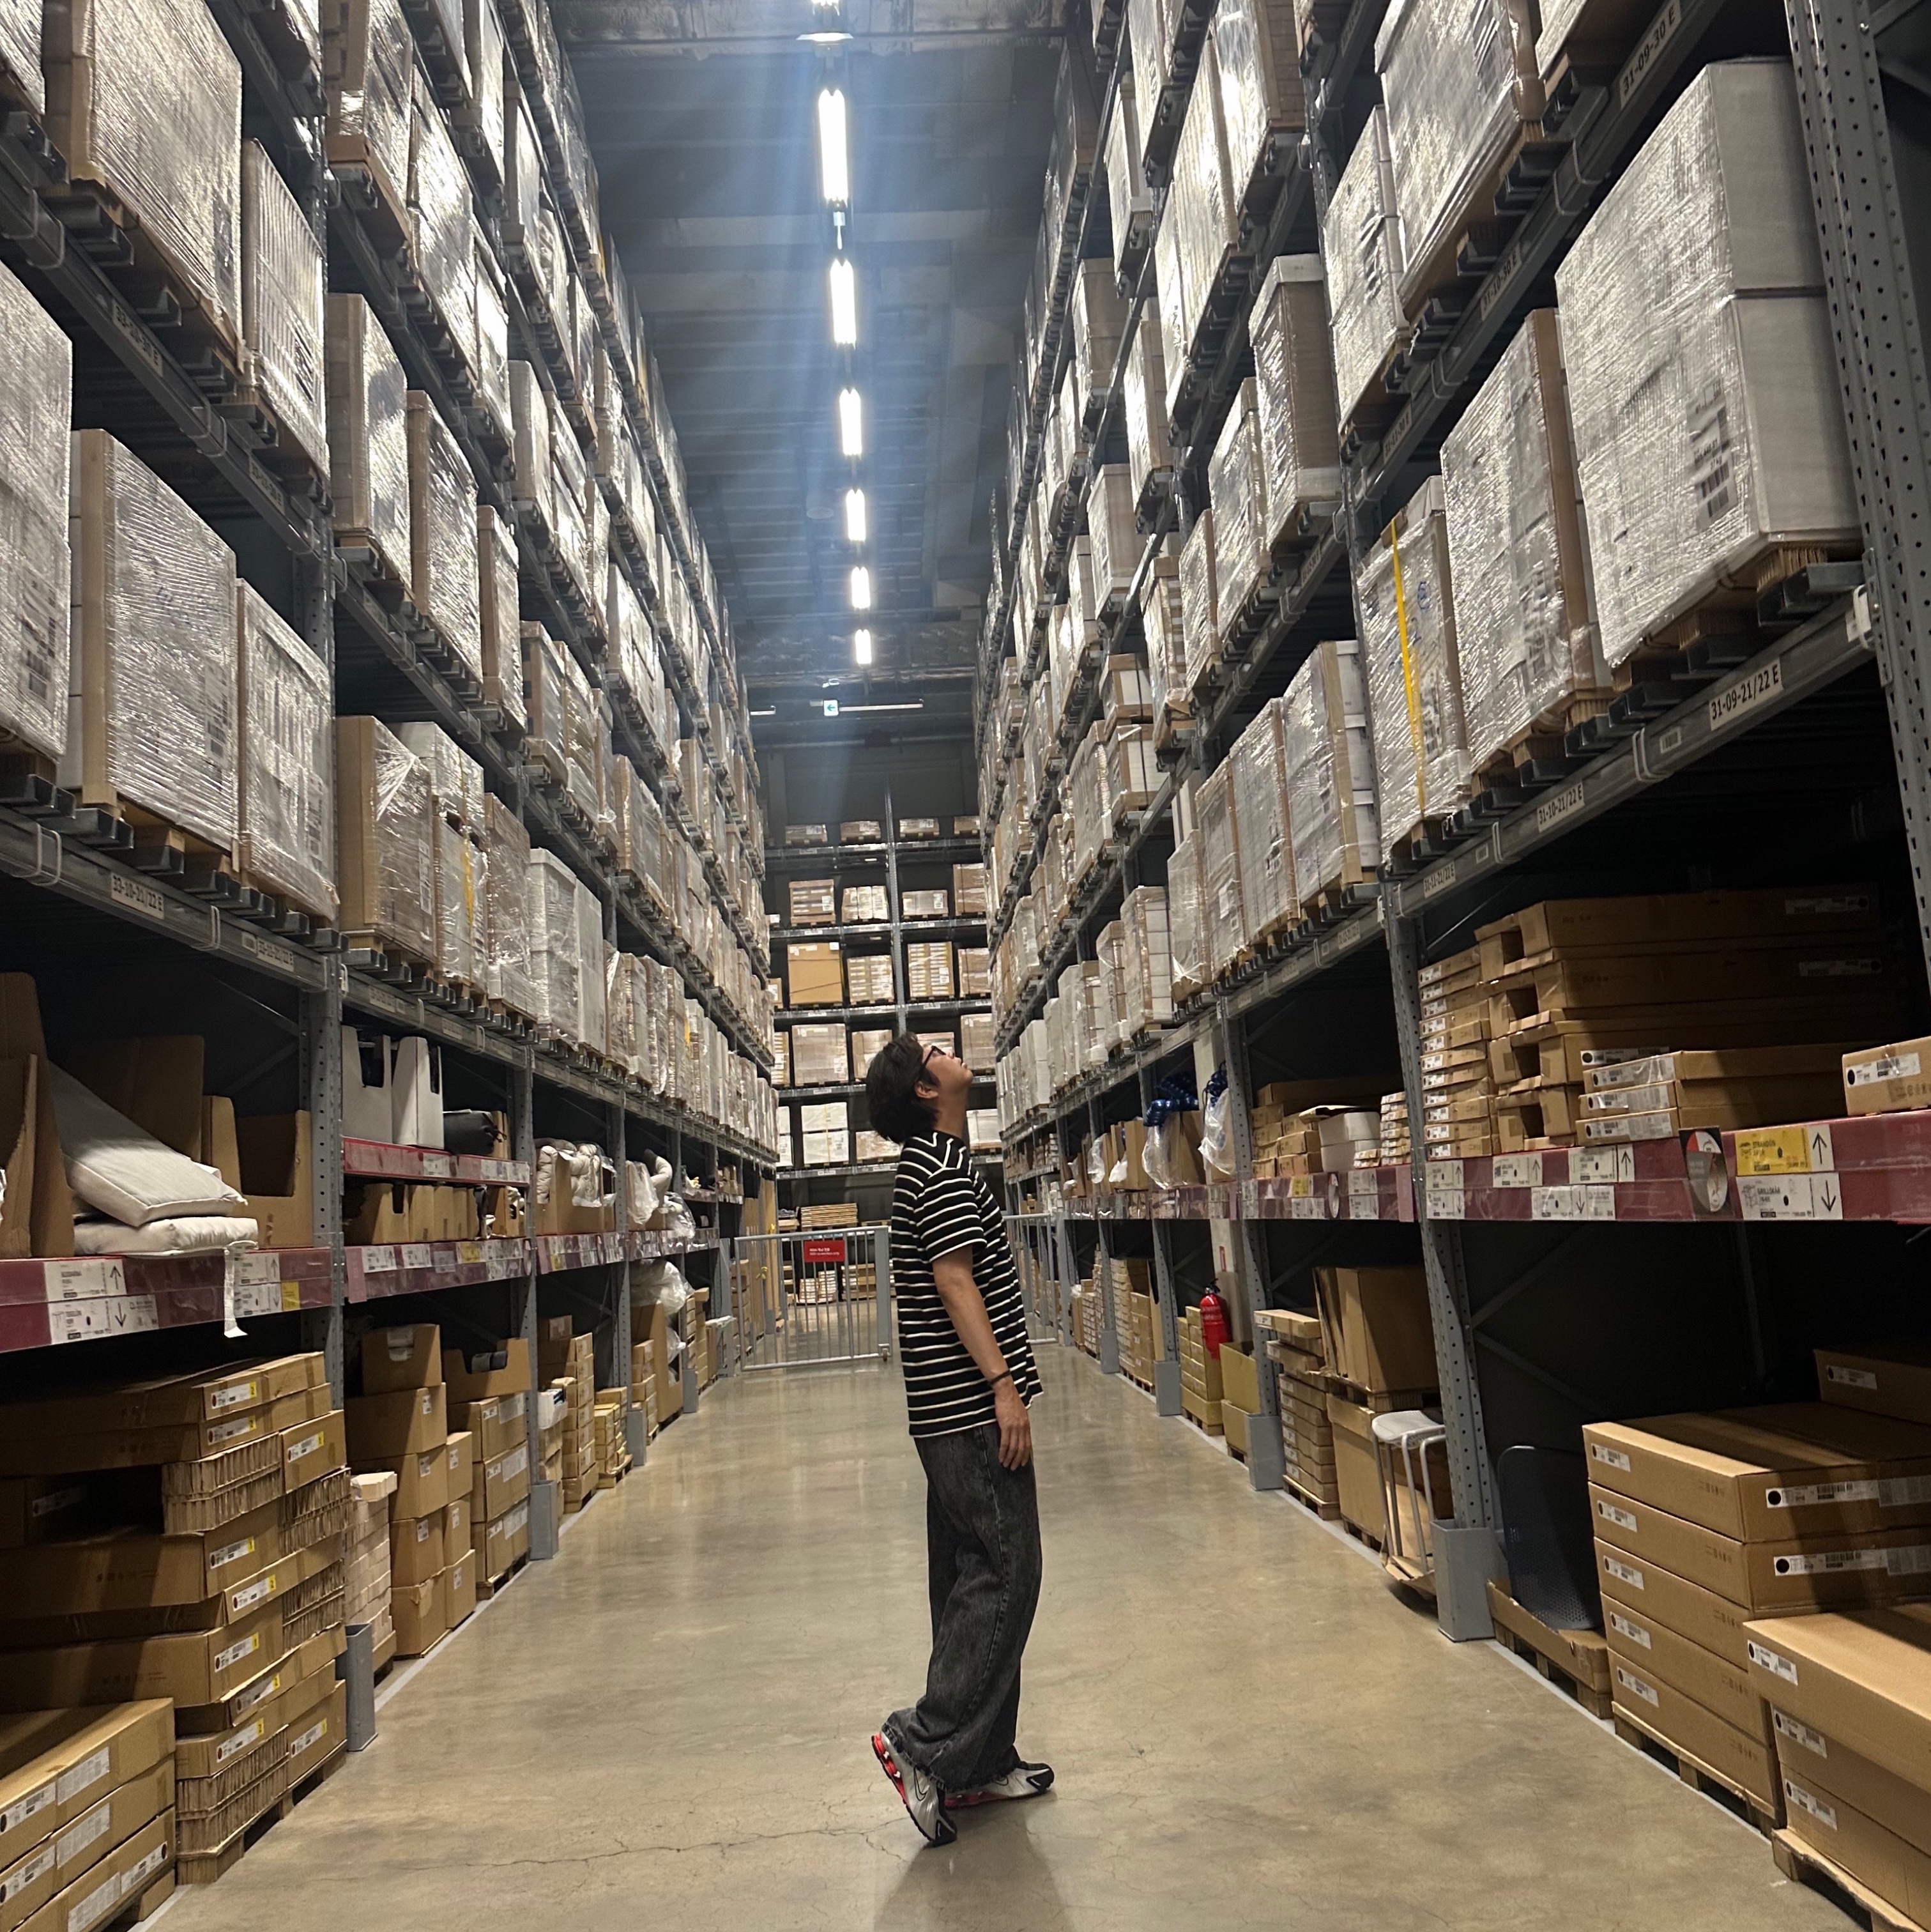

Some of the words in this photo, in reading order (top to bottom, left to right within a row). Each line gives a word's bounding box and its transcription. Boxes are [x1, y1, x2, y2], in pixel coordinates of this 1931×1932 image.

[1622, 20, 1665, 95] 31-09-30
[1668, 3, 1675, 26] E
[1711, 670, 1770, 720] 31-09-21/22
[1772, 664, 1779, 685] E
[1538, 788, 1576, 825] 31-10-21/22
[1578, 784, 1582, 800] E
